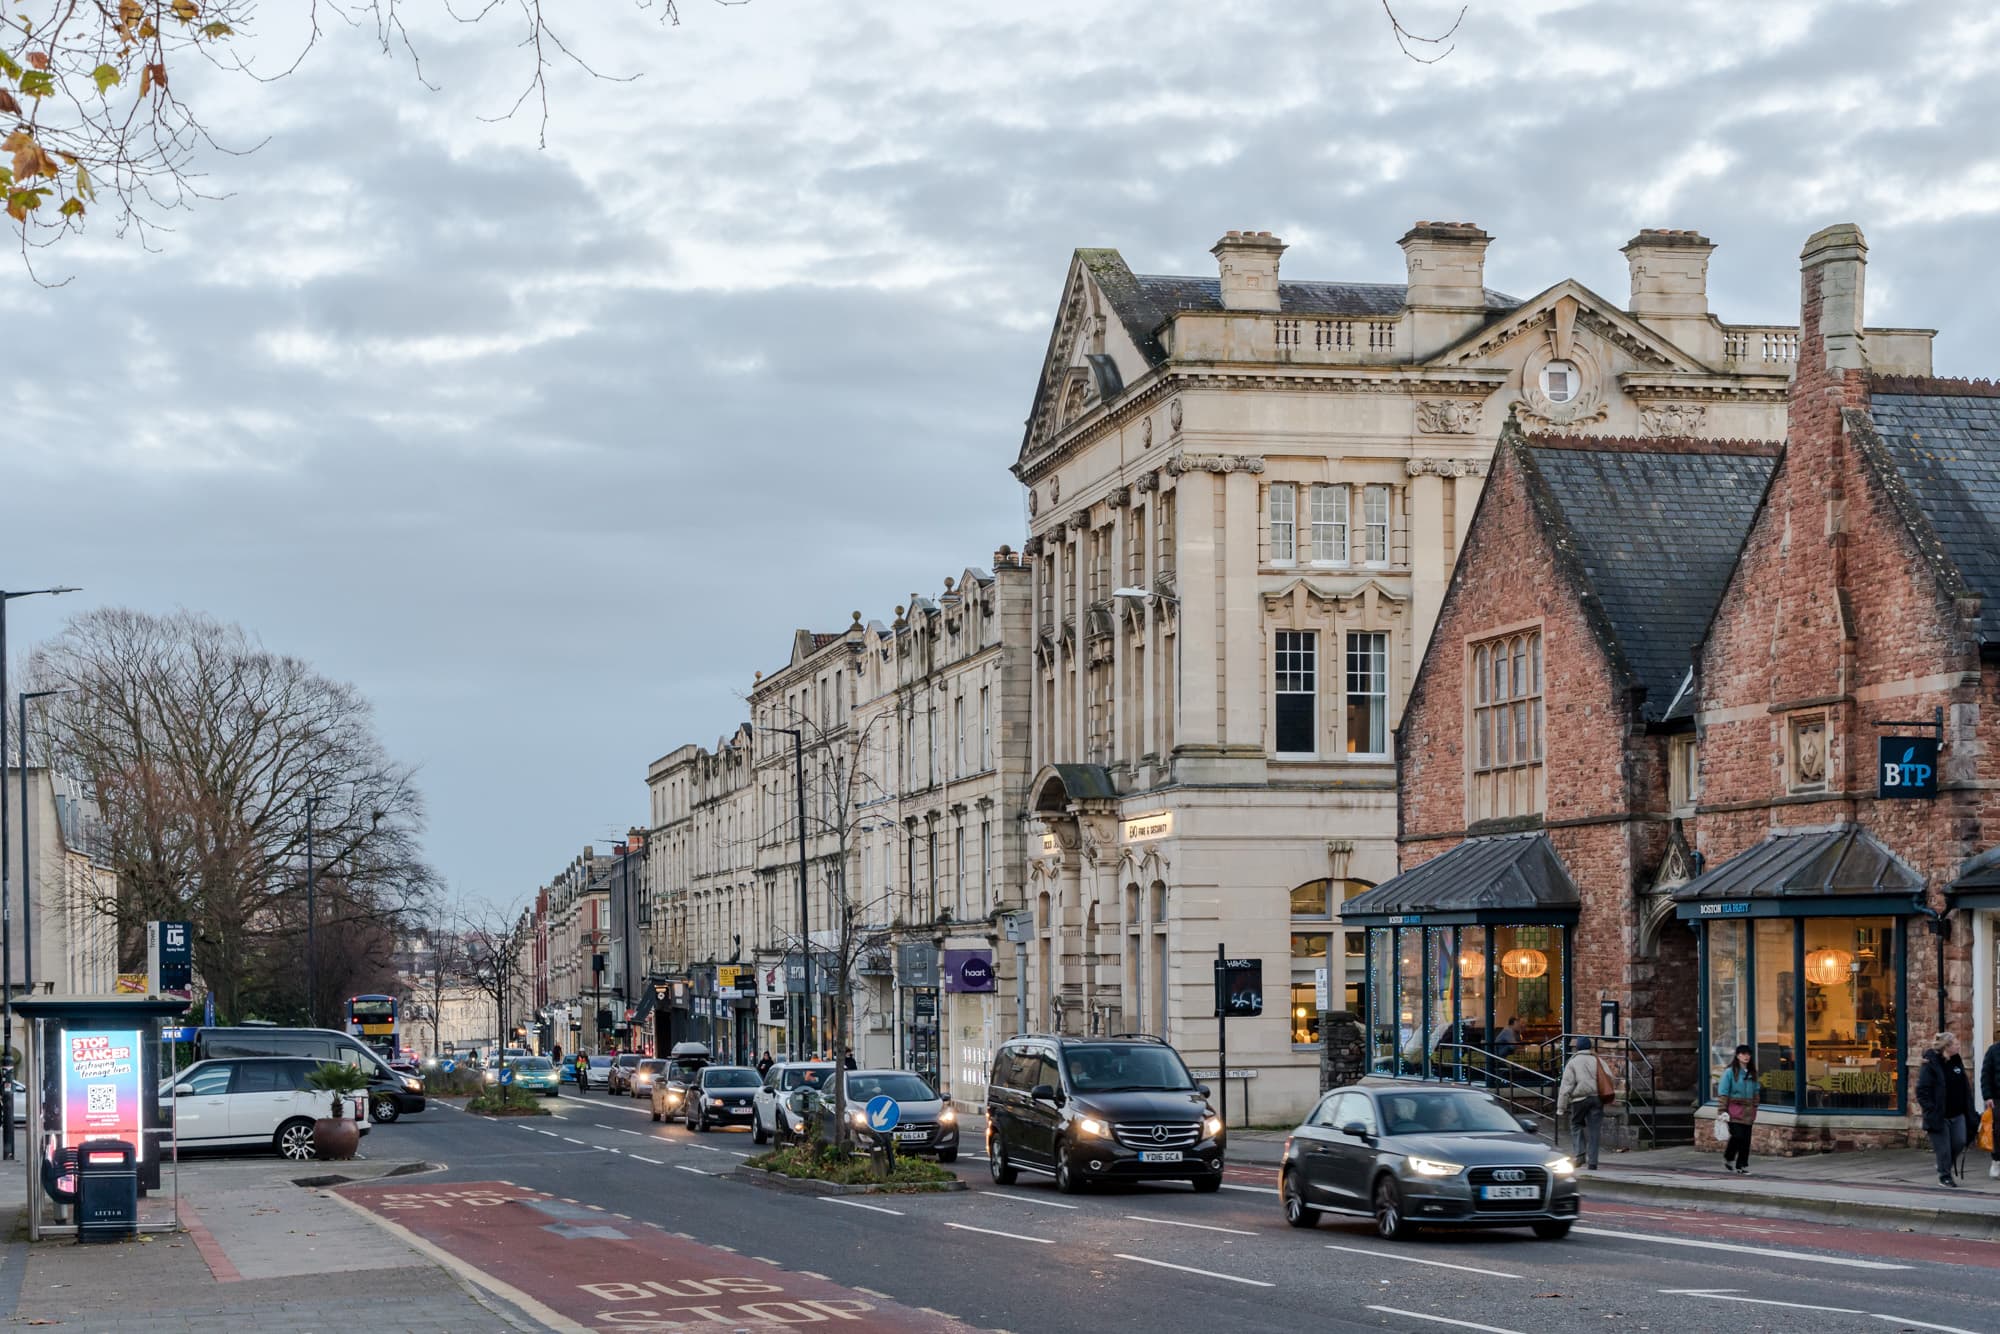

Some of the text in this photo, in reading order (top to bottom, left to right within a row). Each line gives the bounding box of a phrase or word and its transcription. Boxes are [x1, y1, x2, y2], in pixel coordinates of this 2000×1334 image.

[1884, 763, 1931, 787] BTP
[1700, 903, 1749, 914] BOSTON TEA PARTY
[720, 967, 728, 976] TO
[729, 967, 740, 976] LET
[965, 968, 986, 977] haart
[73, 1037, 108, 1049] STOP
[73, 1048, 129, 1061] CANCER
[75, 1061, 115, 1071] destroying
[81, 1065, 130, 1078] teenage lives
[1839, 1071, 1892, 1082] BREAKFAST
[1839, 1080, 1873, 1094] LUNCH
[1145, 1152, 1180, 1160] YD16 GCA
[382, 1190, 504, 1200] BUS
[576, 1277, 785, 1301] BUS
[595, 1300, 876, 1330] STOP
